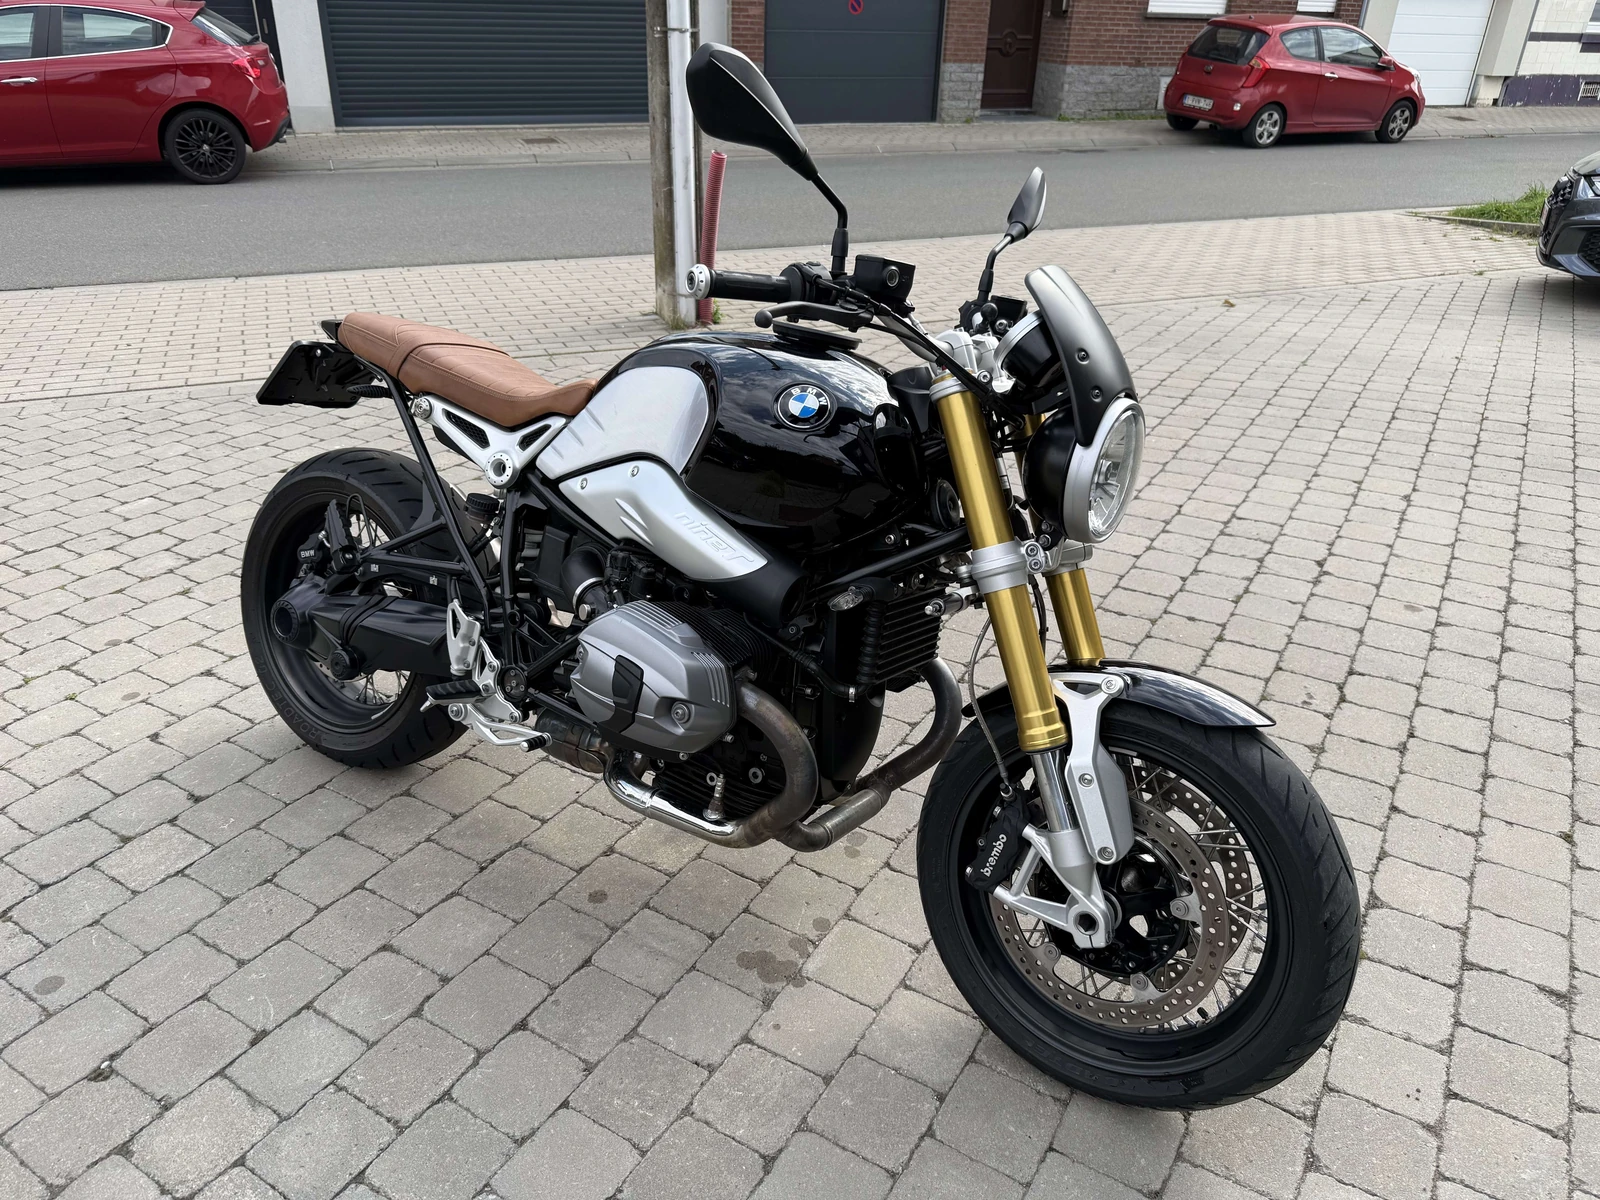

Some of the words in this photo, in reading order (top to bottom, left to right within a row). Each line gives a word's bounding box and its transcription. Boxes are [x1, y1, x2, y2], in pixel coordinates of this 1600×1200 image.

[790, 387, 828, 406] BMW
[300, 549, 315, 558] BMW
[265, 681, 320, 739] ROADTEC
[980, 833, 1007, 878] brembo
